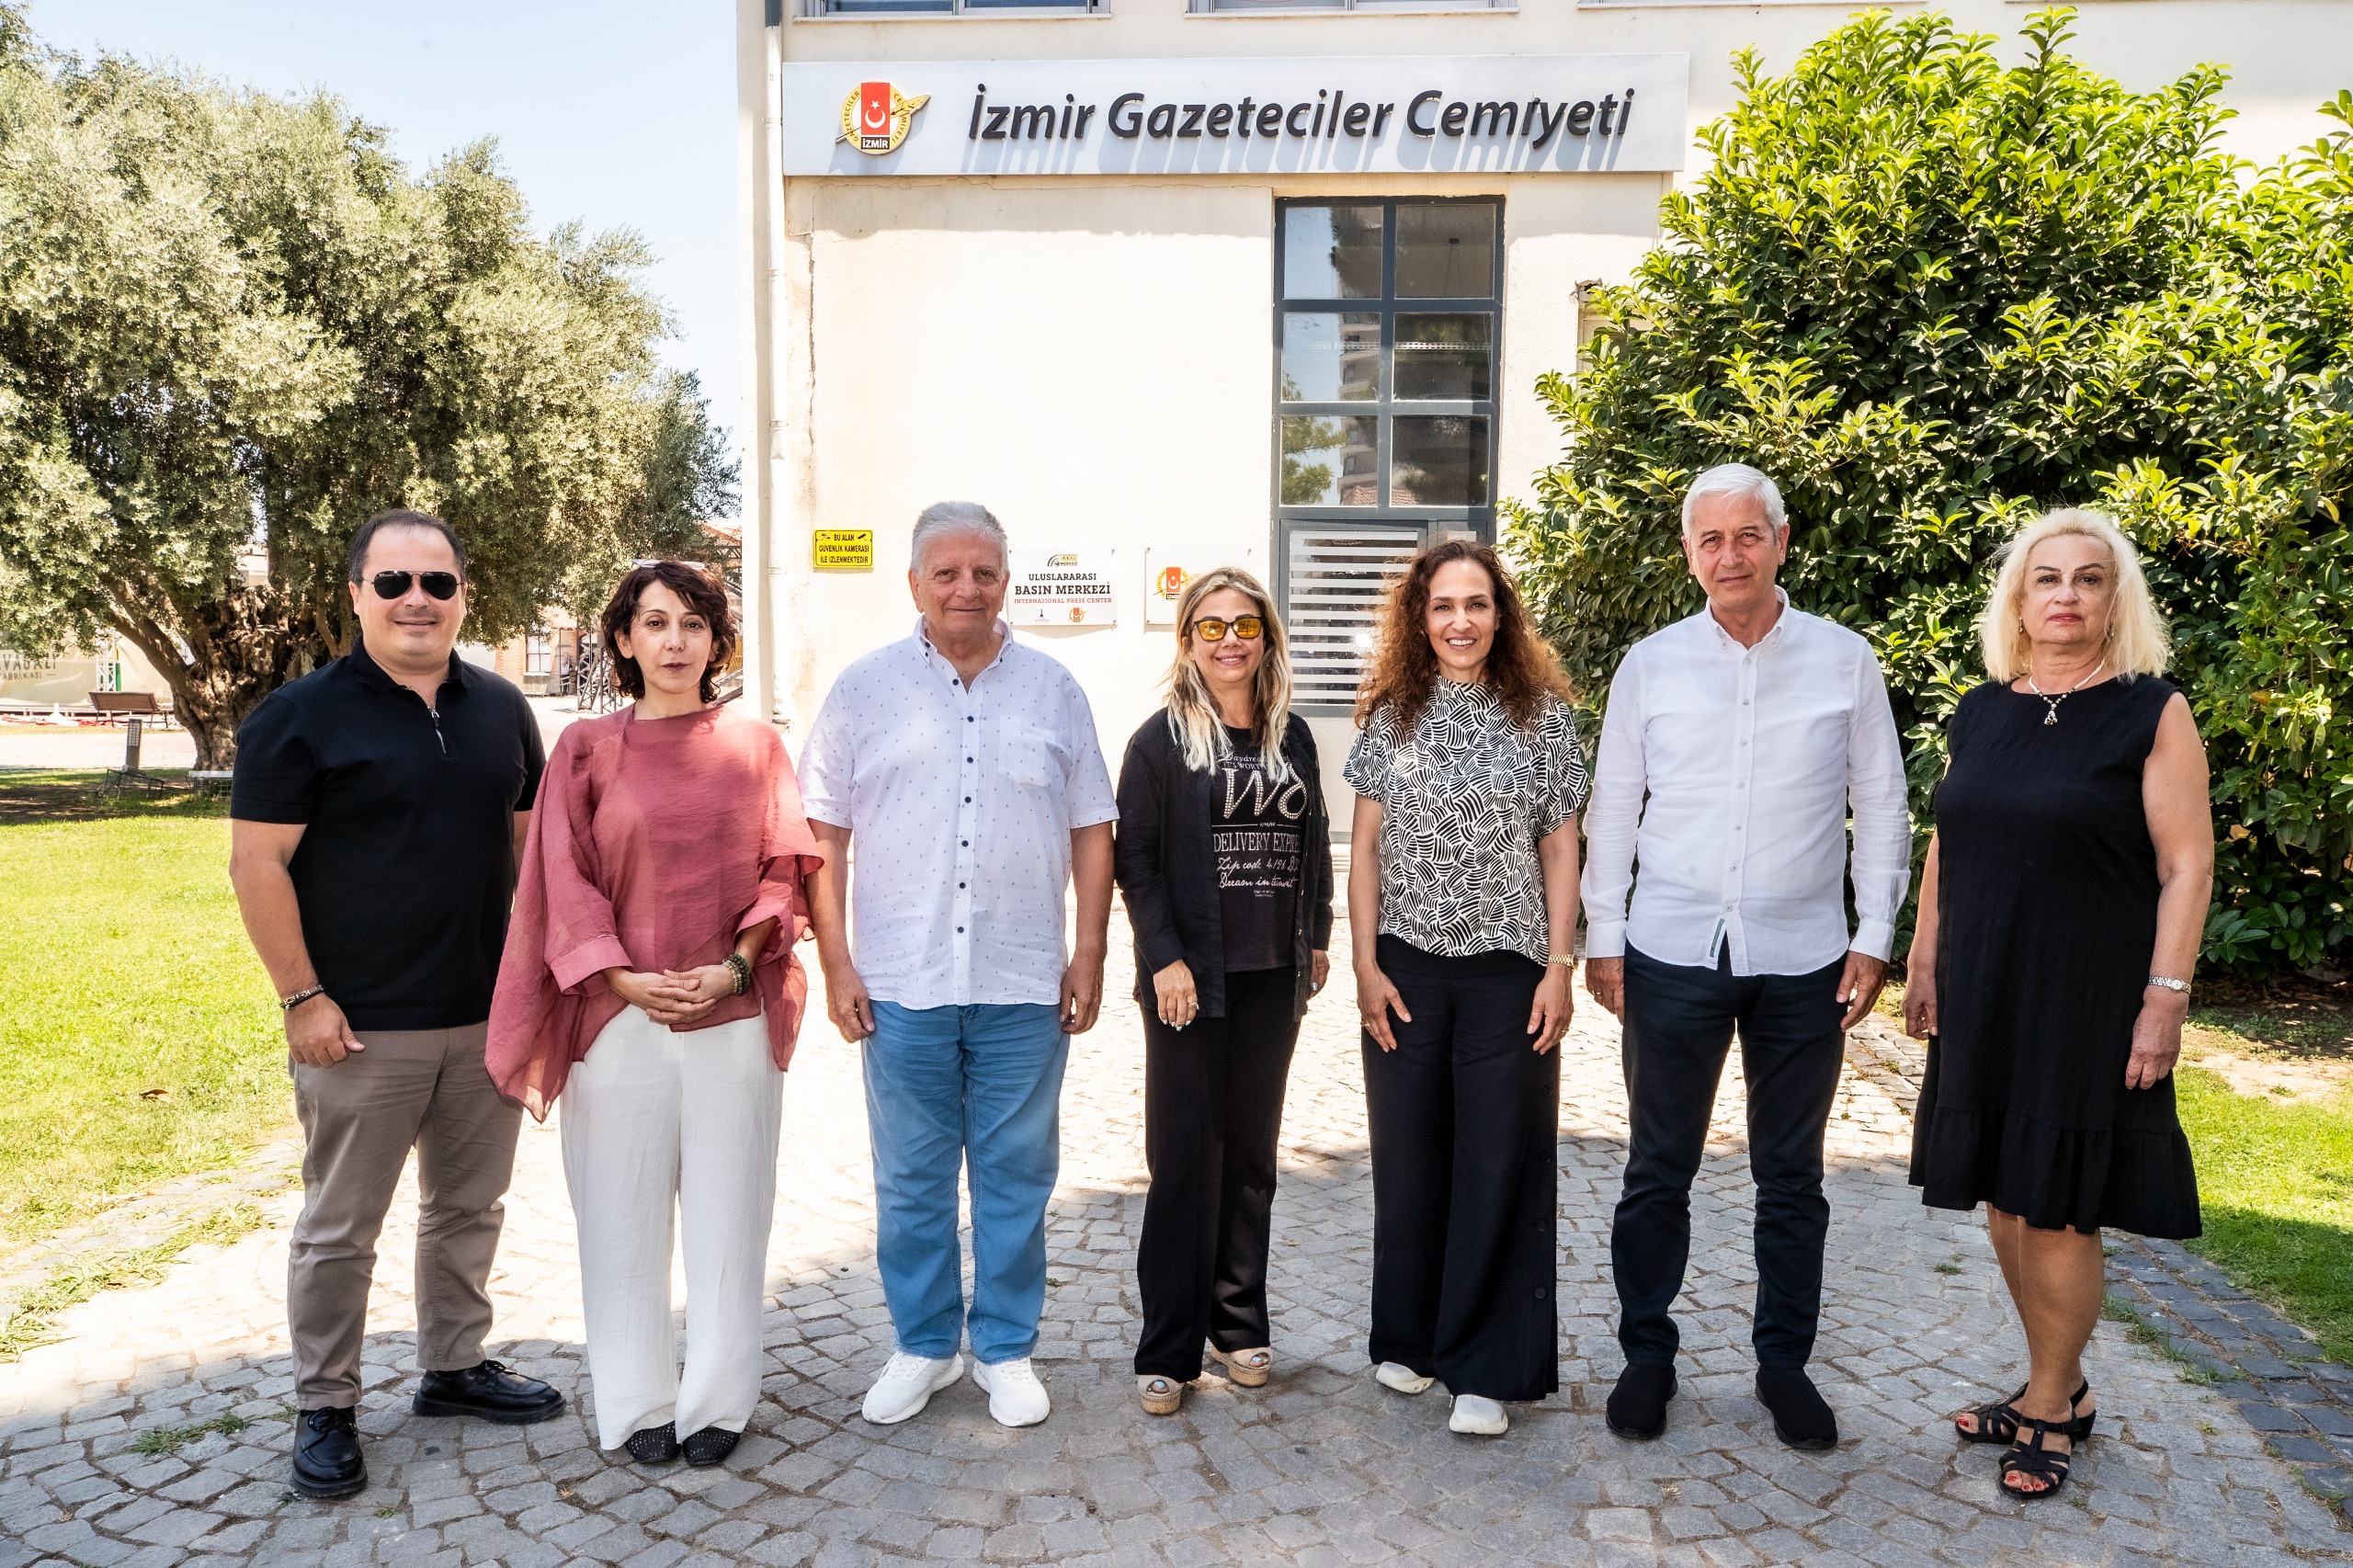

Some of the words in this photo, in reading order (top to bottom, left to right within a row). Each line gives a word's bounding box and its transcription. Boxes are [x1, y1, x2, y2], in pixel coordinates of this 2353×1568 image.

[969, 84, 1096, 140] İzmir
[1108, 89, 1395, 140] Gazeteciler
[1406, 87, 1635, 150] Cemiyeti
[862, 138, 889, 149] İZMİR
[1029, 573, 1097, 581] ULUSLARARASI
[1015, 585, 1052, 596] BASIN
[1055, 582, 1111, 595] MERKEZİ
[1212, 832, 1271, 853] DELIVERY
[1216, 856, 1241, 877] Zip
[1243, 858, 1262, 870] code
[1255, 876, 1270, 887] in
